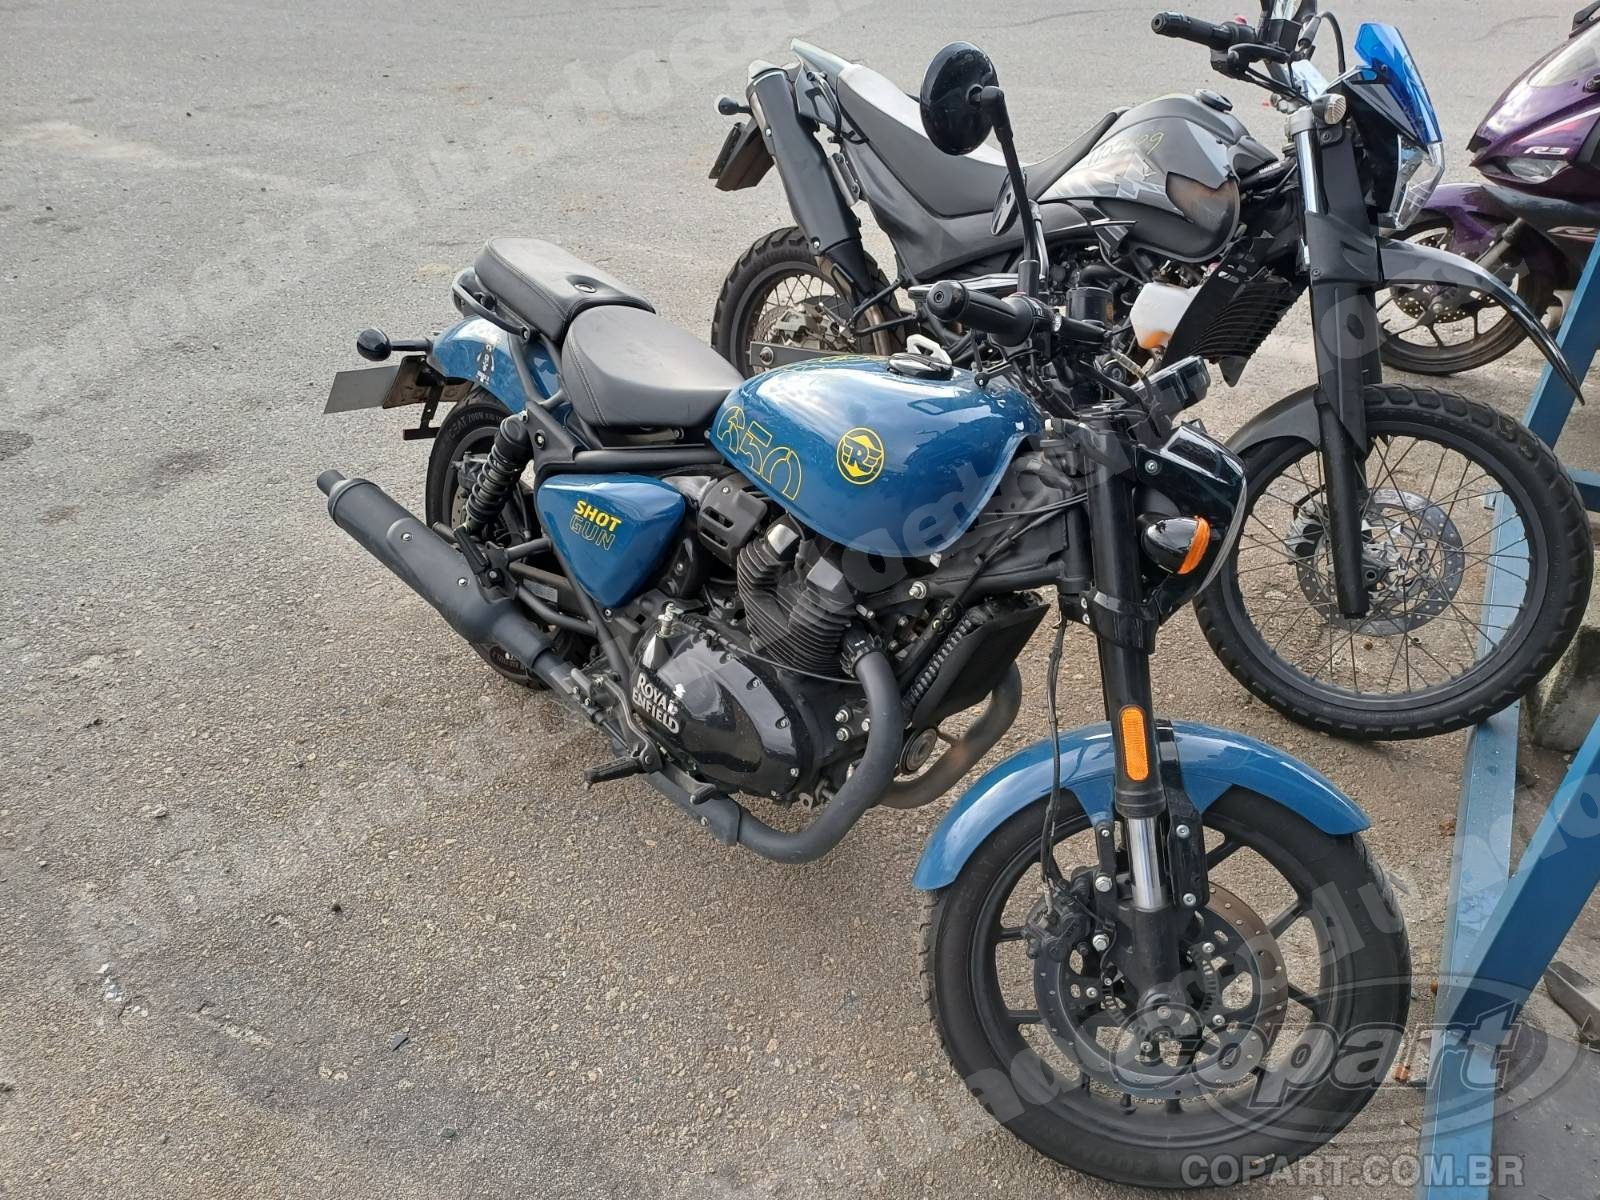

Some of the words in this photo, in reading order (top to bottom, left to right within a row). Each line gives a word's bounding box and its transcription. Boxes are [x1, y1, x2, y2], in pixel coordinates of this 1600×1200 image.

[716, 405, 802, 500] 650
[570, 514, 616, 551] GUN
[574, 500, 622, 532] SHOT
[632, 686, 680, 734] ENFIELD
[637, 672, 679, 715] ROYAL
